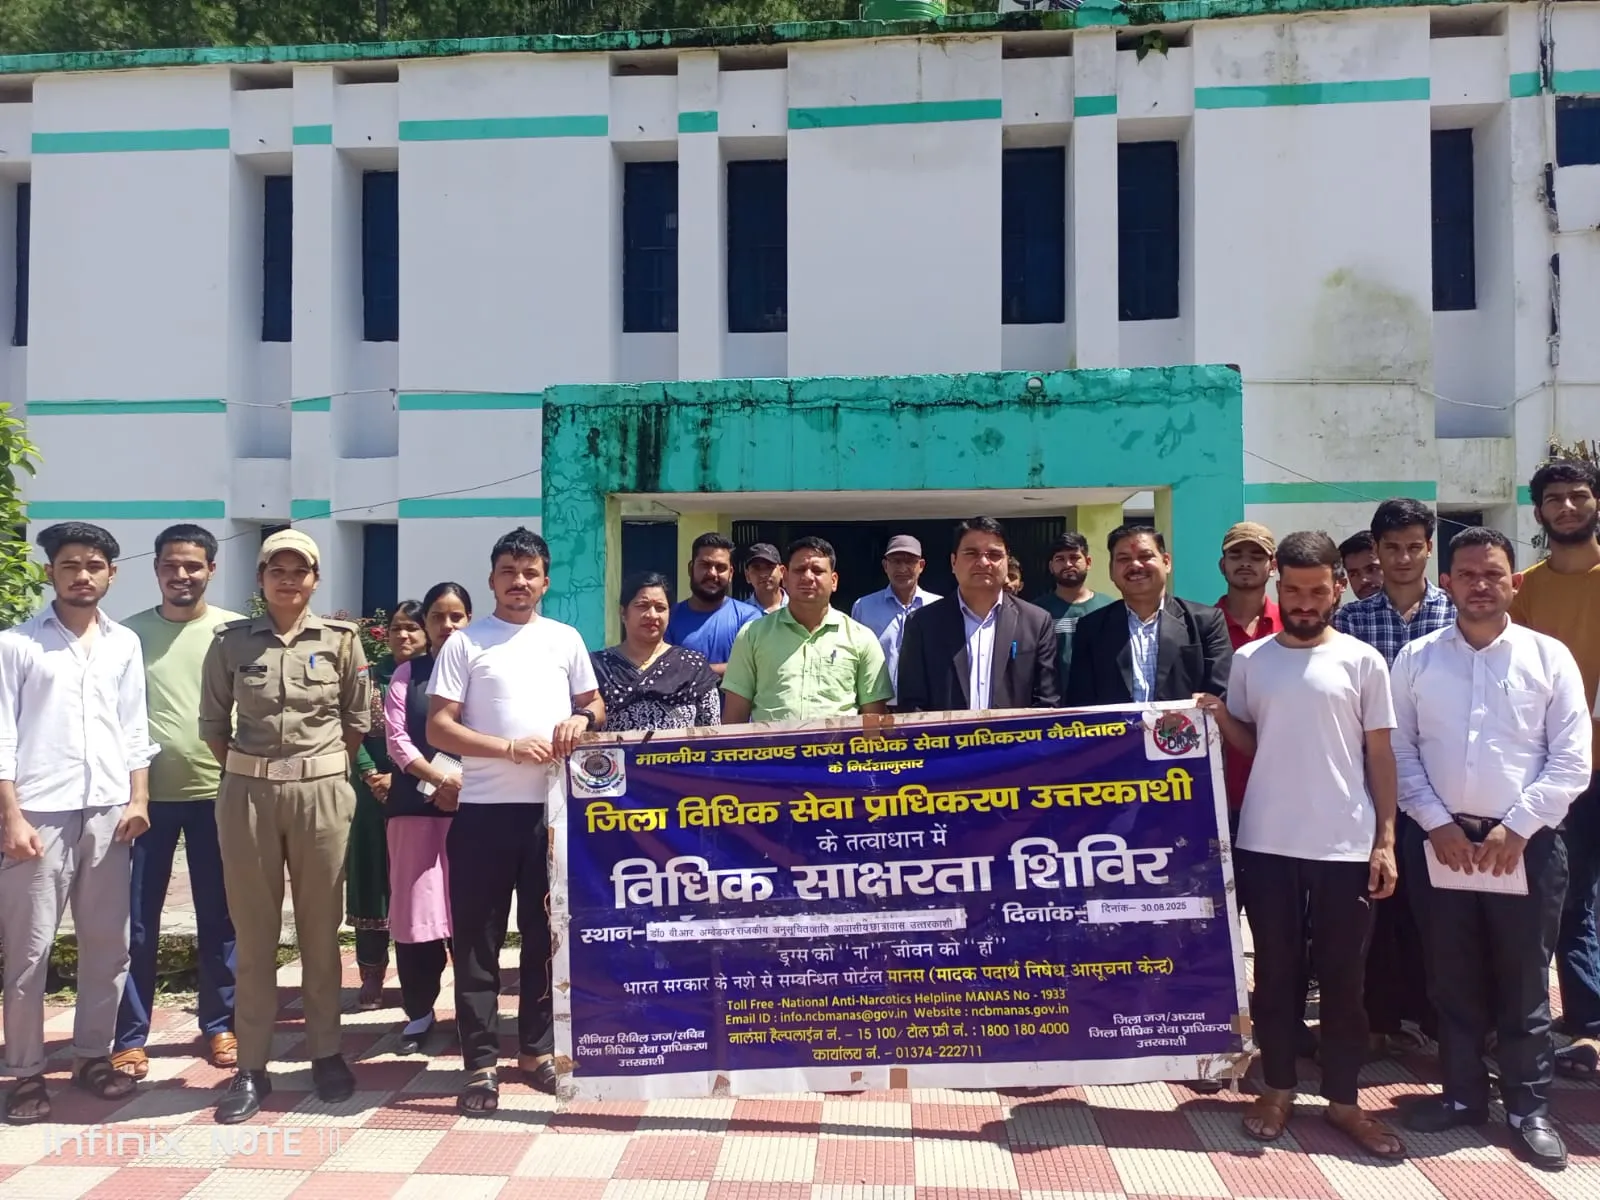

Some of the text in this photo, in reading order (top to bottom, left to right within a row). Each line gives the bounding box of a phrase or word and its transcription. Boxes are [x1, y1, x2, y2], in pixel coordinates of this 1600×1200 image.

[636, 747, 705, 766] माननीय
[711, 744, 796, 763] उत्तराखण्ड
[801, 742, 844, 758] राज्य
[913, 732, 950, 751] सेवा
[955, 728, 1042, 750] प्राधिकरण
[1048, 720, 1127, 740] नैनीताल
[828, 758, 924, 775] के निर्देशानुसार
[585, 768, 1193, 833] जिला विधिक सेवा प्राधिकरण उत्तरकाशी
[816, 822, 947, 853] के तत्वाधान में
[609, 834, 1174, 909] विधिक साक्षरता शिविर
[1141, 901, 1187, 912] 30.08.2025
[777, 949, 809, 967] ड्रग्स
[891, 938, 933, 959] जीवन
[937, 936, 960, 957] को
[624, 980, 658, 995] भारत
[663, 977, 710, 993] सरकार
[714, 973, 728, 990] के
[732, 971, 756, 989] नशे
[760, 970, 774, 988] से
[843, 966, 883, 985] पोर्टल
[887, 967, 925, 983] मानस
[929, 966, 977, 984] (मादक
[982, 960, 1020, 980] पदार्थ
[1024, 960, 1065, 978] निषेध
[1072, 960, 1132, 982] आसूचना
[1136, 955, 1174, 976] केन्द्र)
[727, 1000, 747, 1011] Toll
[750, 999, 774, 1010] Free
[832, 993, 911, 1007] Anti-Narcotics
[914, 992, 962, 1005] Helpline
[966, 990, 1010, 1002] MANAS
[1014, 990, 1030, 1001] No
[1041, 989, 1066, 1000] 1933
[725, 1012, 755, 1025] Email
[759, 1013, 771, 1023] ID
[780, 1009, 907, 1023] info.ncbmanas@gov.in
[914, 1006, 961, 1018] Website
[972, 1003, 1069, 1018] ncbmanas.gov.in
[1113, 1013, 1141, 1025] जिला
[858, 1028, 871, 1039] 15
[906, 1022, 929, 1038] टोल
[932, 1022, 949, 1037] फ्री
[981, 1024, 1009, 1036] 1800
[1014, 1024, 1035, 1035] 180
[1039, 1023, 1069, 1035] 4000
[1088, 1022, 1232, 1038] जिला विधिक सेवा प्राधिकरण
[579, 1034, 615, 1045] सीनियर
[1136, 1036, 1186, 1048] उत्तरकाशी
[576, 1046, 602, 1056] जिला
[638, 1043, 658, 1055] सेवा
[661, 1041, 708, 1054] प्राधिकरण
[812, 1046, 862, 1061] कार्यालय
[896, 1045, 982, 1058] 01374-222711
[618, 1054, 665, 1067] उत्तरकाशी
